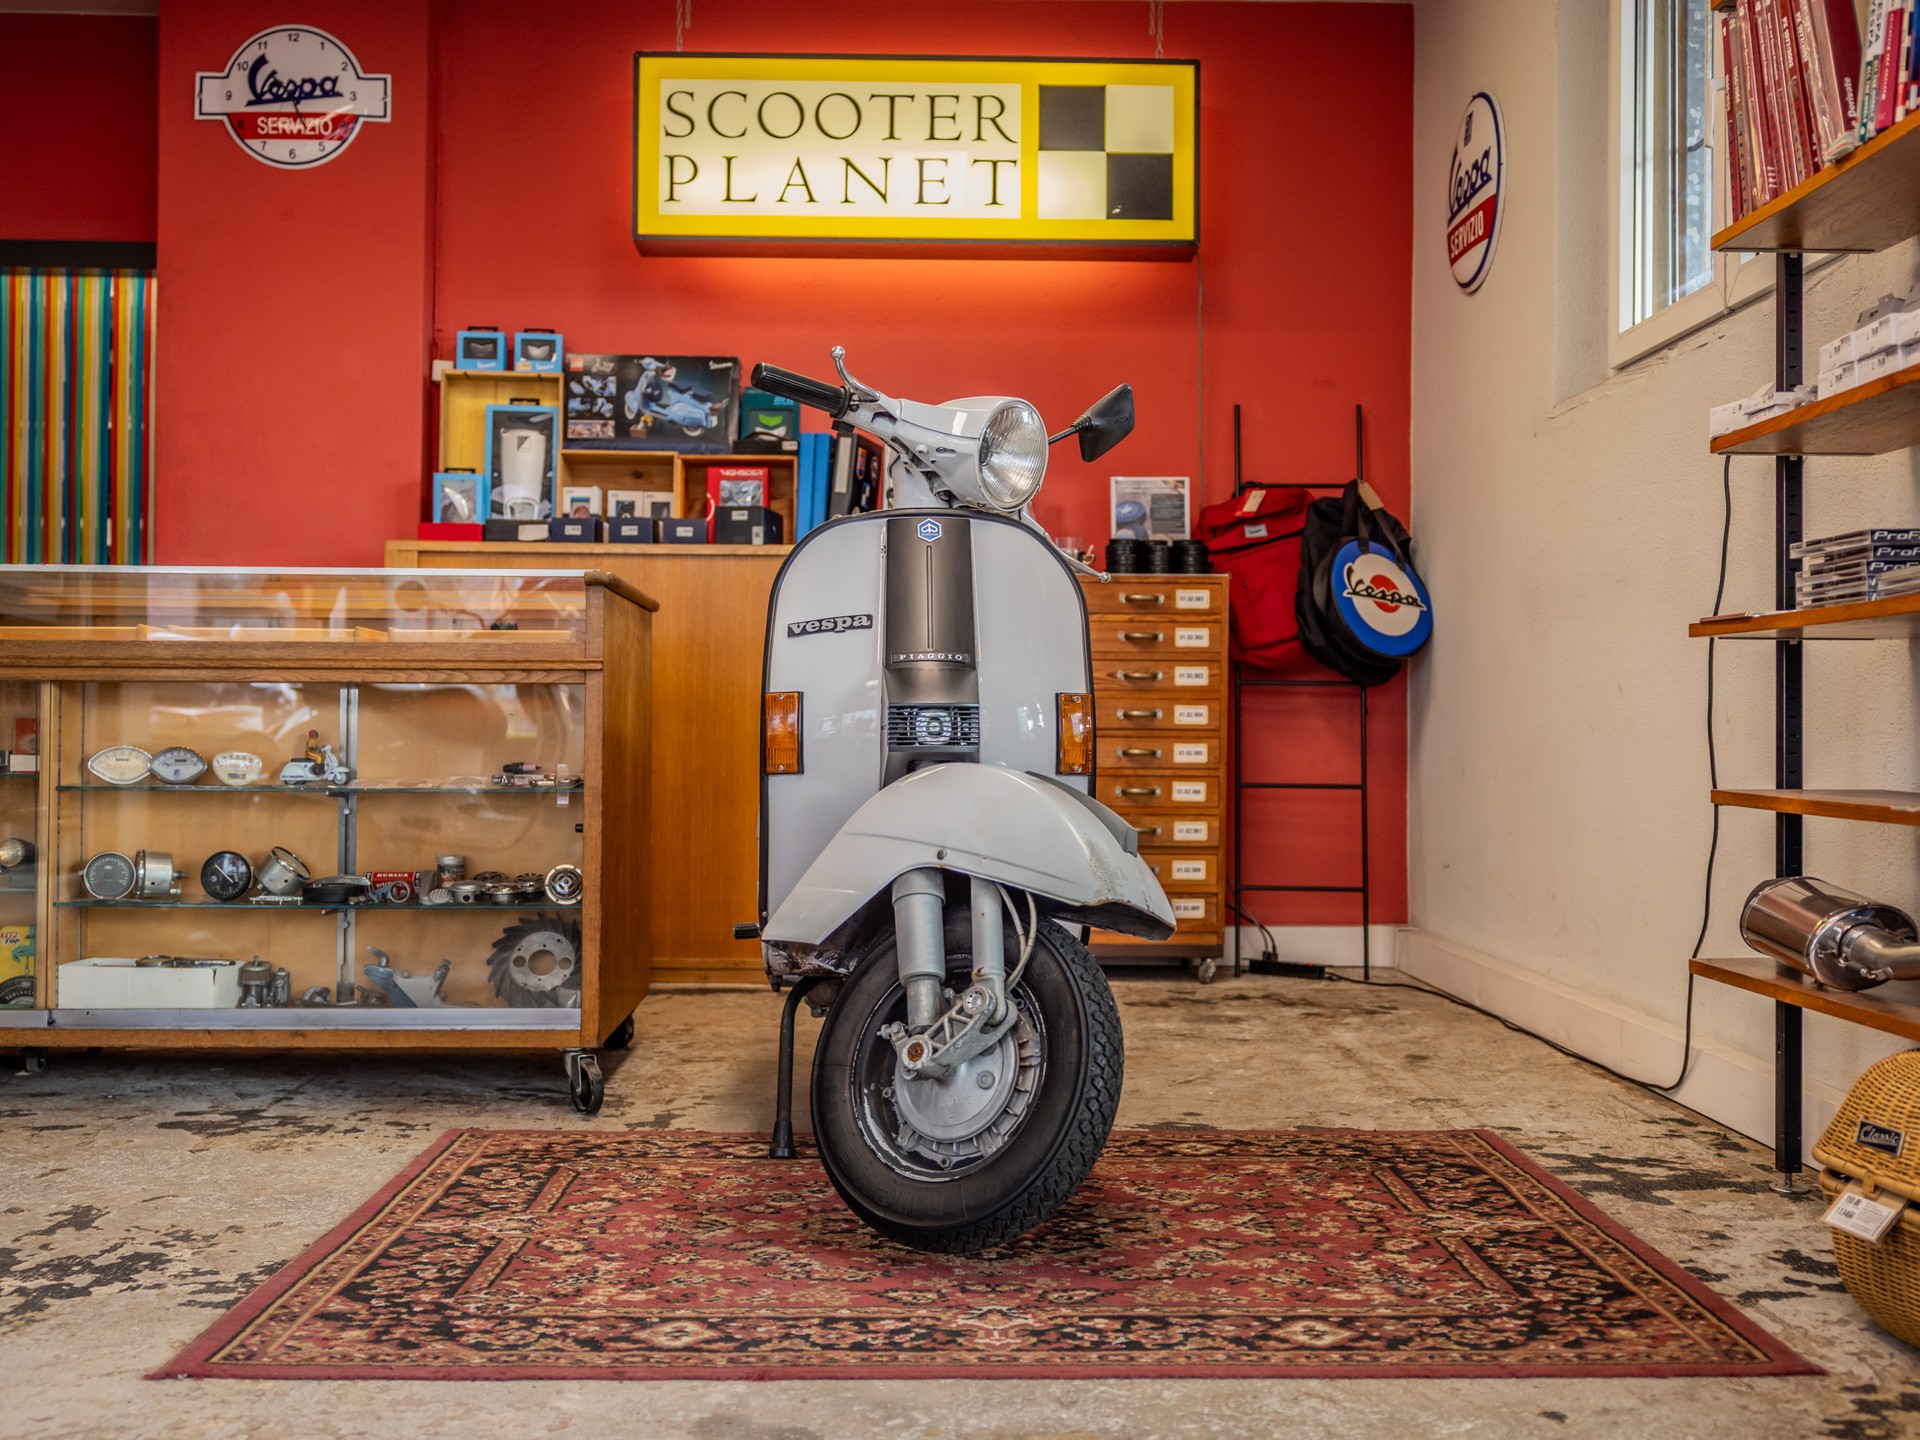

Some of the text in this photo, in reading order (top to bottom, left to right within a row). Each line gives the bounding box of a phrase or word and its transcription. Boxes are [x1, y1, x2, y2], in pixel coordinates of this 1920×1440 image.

[1729, 18, 1736, 30] 2
[288, 32, 300, 42] 12
[257, 40, 268, 50] 11
[320, 41, 325, 50] 1
[237, 61, 249, 71] 10
[341, 61, 348, 72] 2
[245, 53, 344, 108] Vespa
[226, 90, 232, 101] 9
[350, 91, 357, 101] 3
[663, 89, 1019, 144] SCOOTER
[256, 116, 333, 135] SERVIZIO
[260, 141, 267, 151] 7
[318, 141, 326, 152] 5
[289, 148, 296, 159] 6
[663, 154, 1018, 207] PLANET
[1448, 144, 1493, 228] Vespa
[1450, 209, 1484, 258] SERVIZIO
[1874, 530, 1920, 540] ProF
[1345, 564, 1425, 609] Vespa
[788, 614, 871, 635] vespa
[898, 653, 963, 661] PIAGGIO
[1858, 1125, 1900, 1146] Classic
